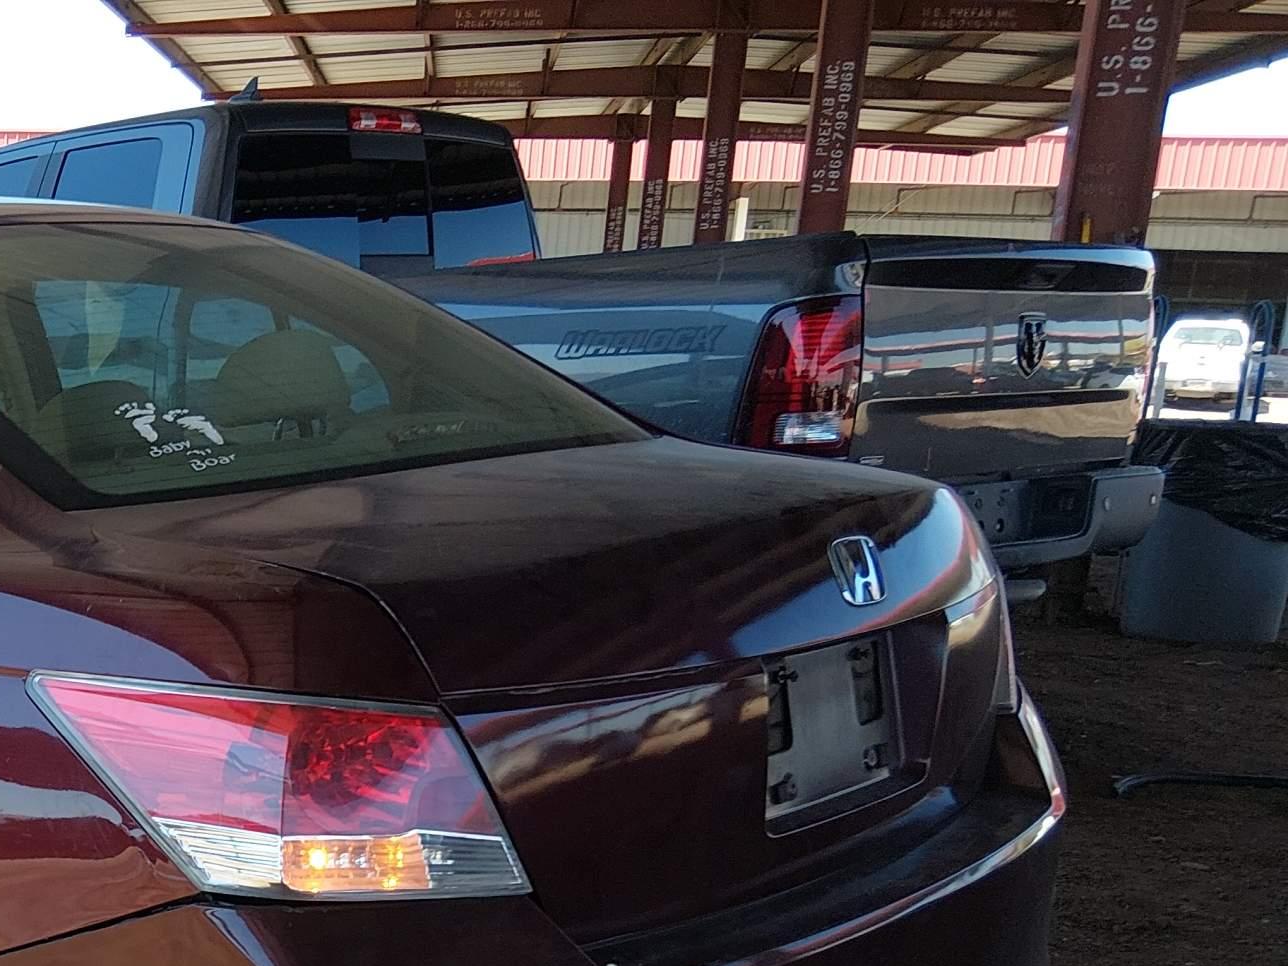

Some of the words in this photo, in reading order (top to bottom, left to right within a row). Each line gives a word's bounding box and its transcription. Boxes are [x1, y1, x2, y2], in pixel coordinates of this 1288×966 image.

[824, 60, 841, 90] INC.
[1096, 46, 1127, 97] U.S.
[816, 97, 835, 156] PREFAB
[825, 61, 856, 193] 1-866-799-0969
[810, 165, 826, 193] U.S.
